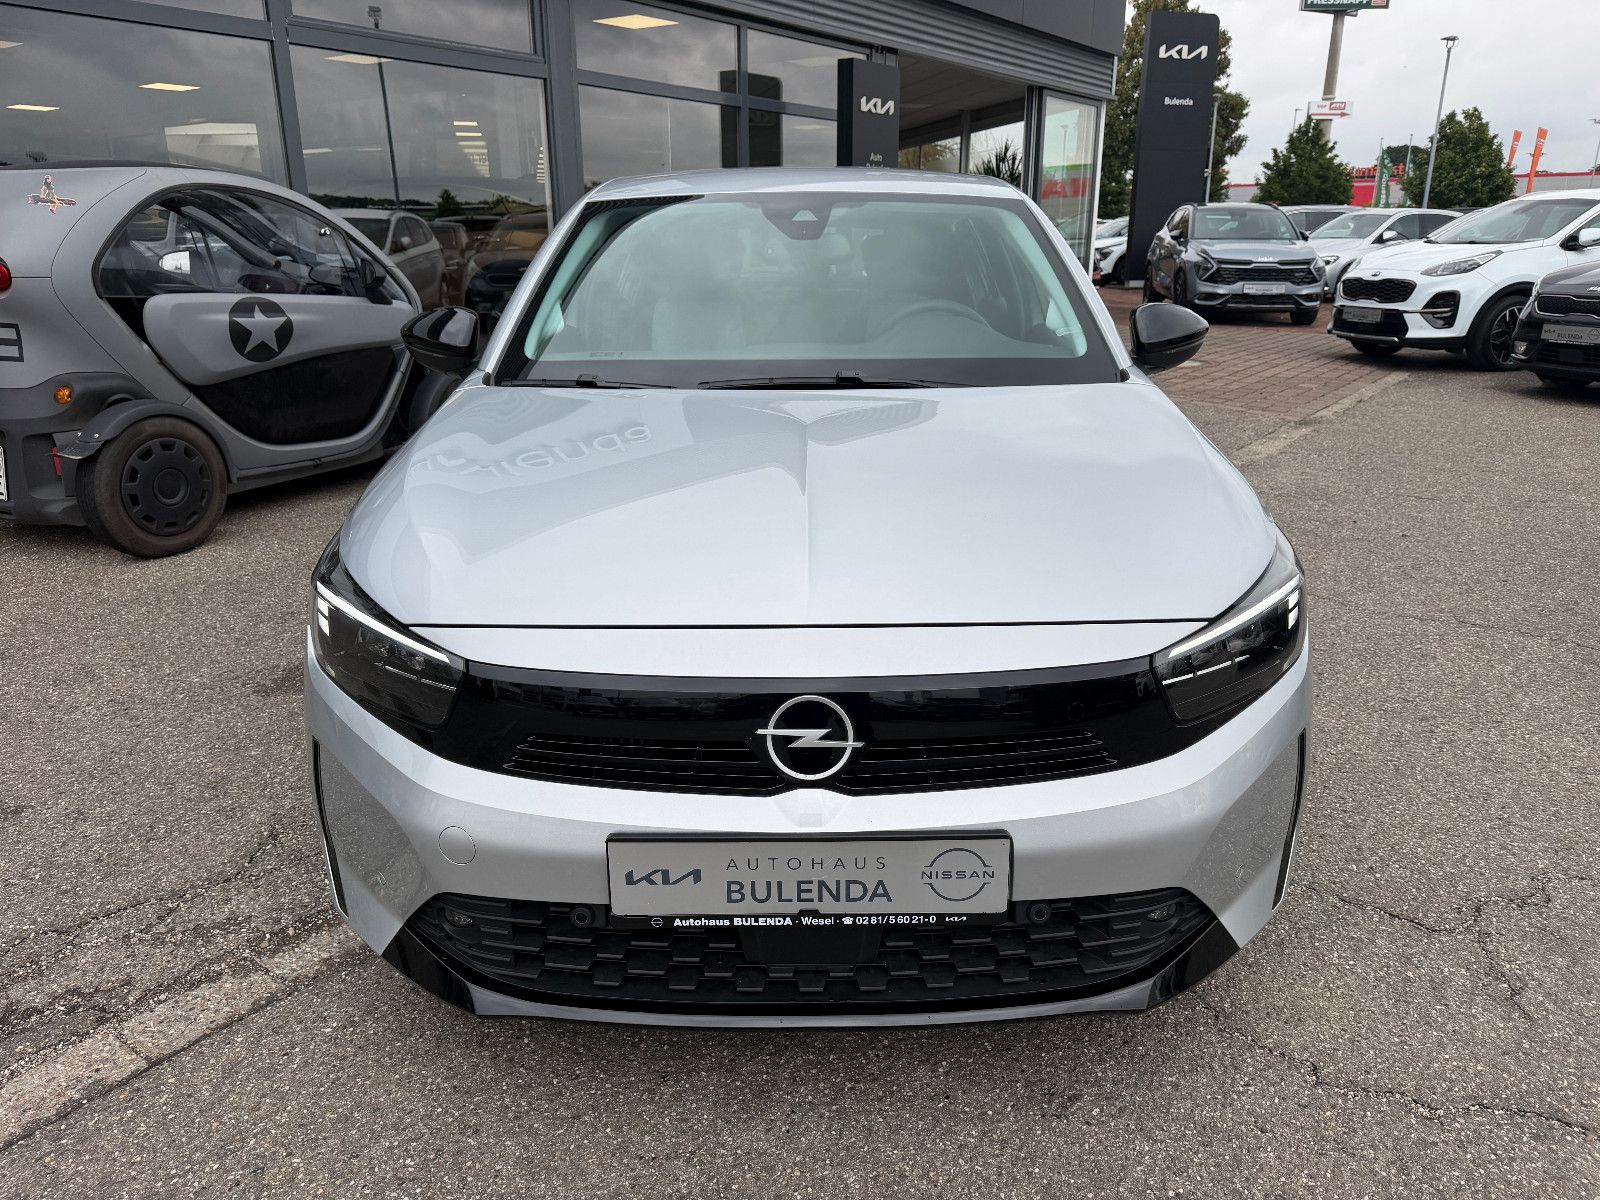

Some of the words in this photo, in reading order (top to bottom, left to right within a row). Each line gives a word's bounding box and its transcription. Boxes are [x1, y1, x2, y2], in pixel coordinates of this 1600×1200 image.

[1159, 44, 1208, 60] KIA
[860, 95, 895, 115] KIA
[1164, 96, 1193, 106] Bulenda
[726, 856, 886, 871] AUTOHAUS
[625, 868, 701, 886] KIA
[921, 870, 994, 880] NISSAN
[726, 880, 893, 903] BULENDA
[673, 917, 730, 927] Autohaus
[733, 916, 792, 926] BULENDA
[801, 915, 834, 925] Wesel
